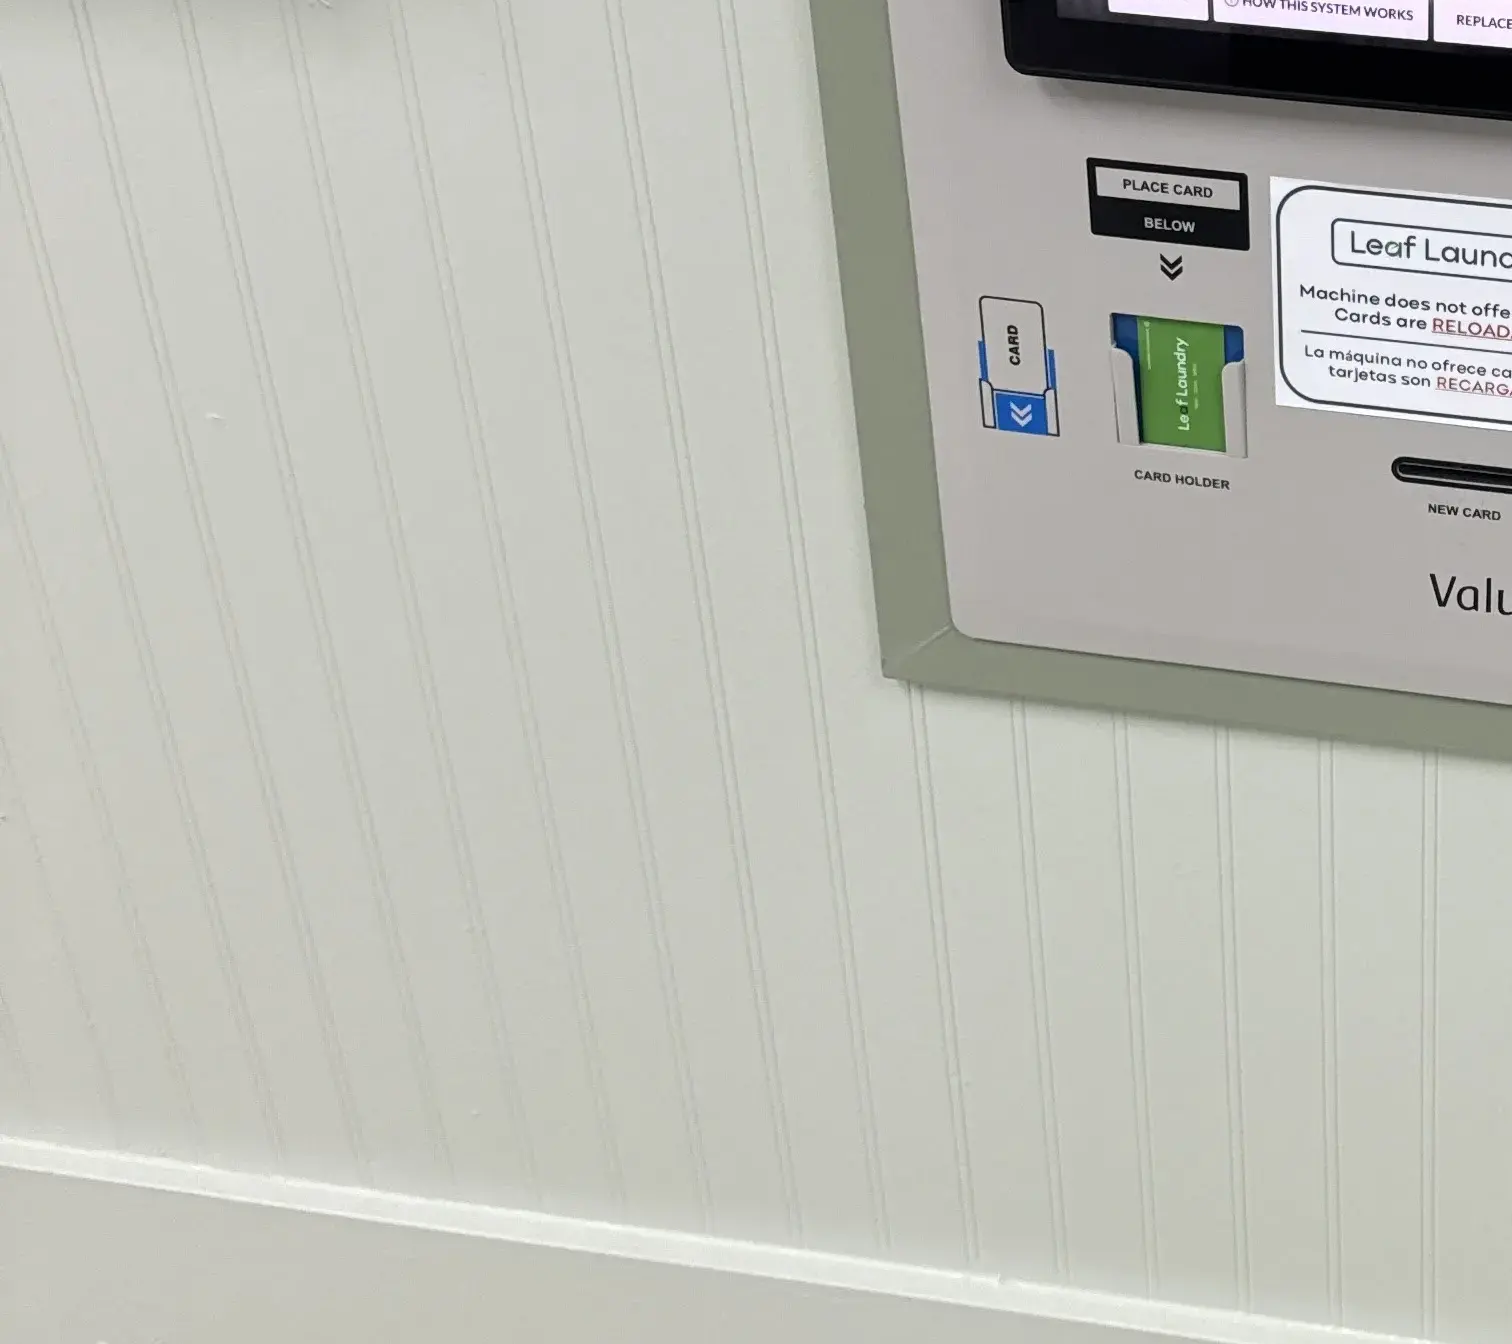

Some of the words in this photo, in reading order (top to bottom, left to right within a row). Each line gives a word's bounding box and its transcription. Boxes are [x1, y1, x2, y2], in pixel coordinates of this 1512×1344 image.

[1310, 0, 1361, 17] SYSTEM
[1363, 5, 1414, 22] WORKS
[1122, 178, 1170, 195] PLACE
[1173, 184, 1213, 199] CARD
[1144, 216, 1196, 233] BELOW
[1350, 230, 1416, 259] Leaf
[1299, 284, 1380, 307] Machine
[1384, 293, 1431, 312] does
[1436, 300, 1467, 315] not
[1334, 307, 1392, 327] Cards
[1396, 315, 1428, 331] are
[1009, 324, 1020, 367] CARD
[1173, 336, 1190, 397] Laundry
[1304, 344, 1325, 359] La
[1329, 349, 1402, 366] máquina
[1406, 358, 1428, 370] no
[1431, 359, 1487, 377] ofrece
[1328, 365, 1397, 384] tarjetas
[1400, 375, 1431, 388] son
[1176, 398, 1190, 432] Leaf
[1134, 469, 1172, 484] CARD
[1175, 473, 1231, 491] HOLDER
[1427, 503, 1459, 518] NEW
[1462, 506, 1502, 522] CARD
